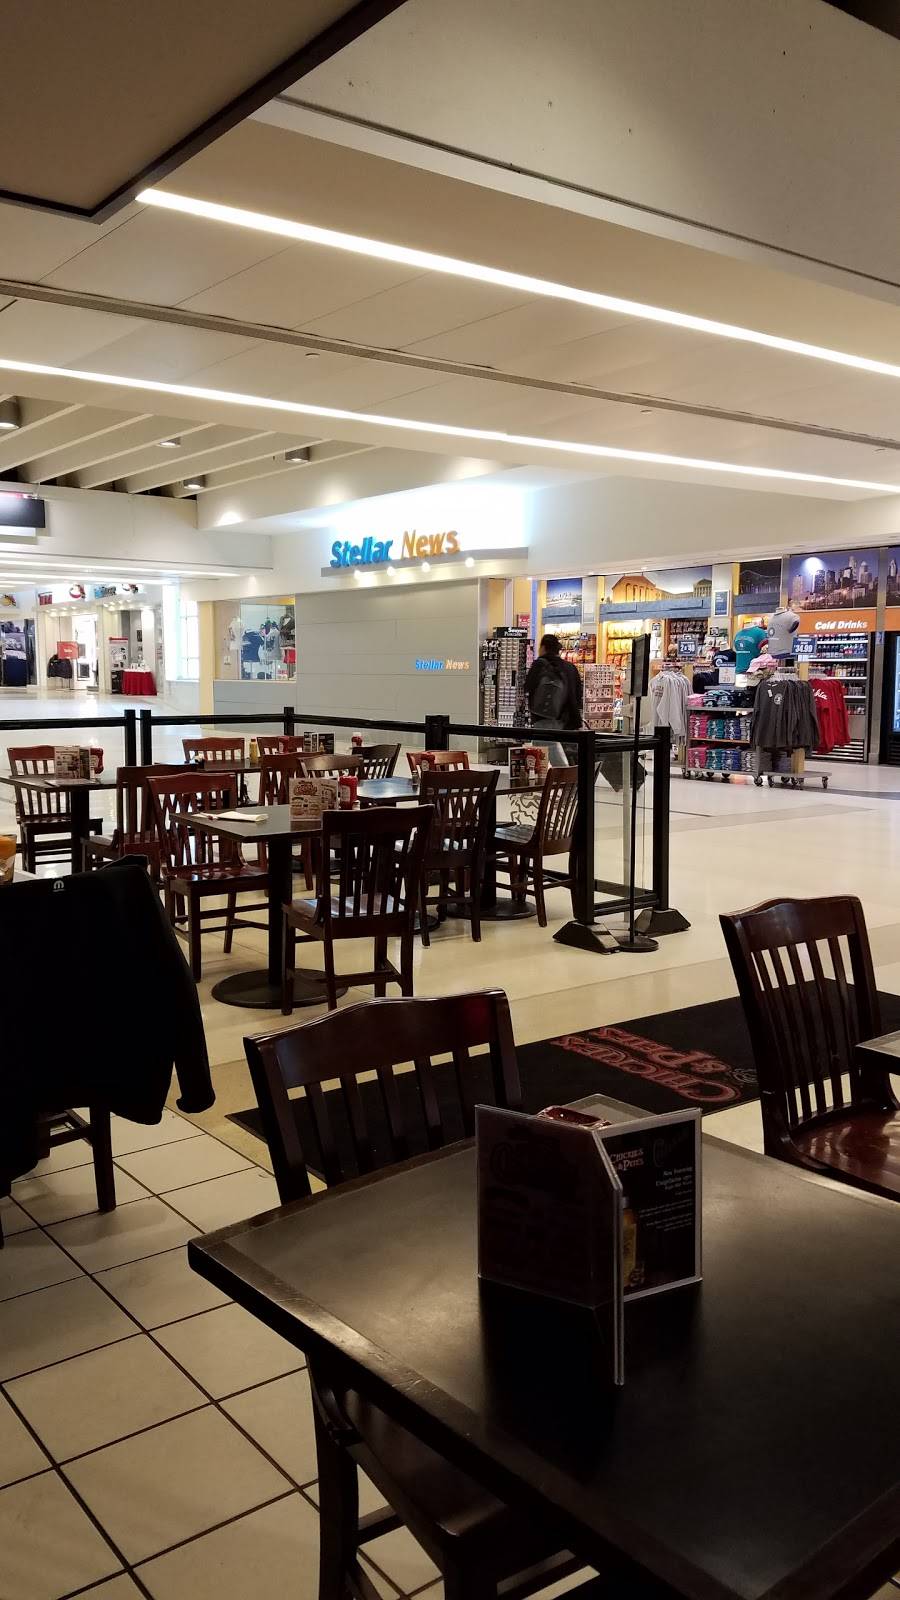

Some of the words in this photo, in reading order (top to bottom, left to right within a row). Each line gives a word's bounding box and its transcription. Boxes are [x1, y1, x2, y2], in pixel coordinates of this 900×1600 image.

[330, 536, 394, 568] Stellar
[401, 529, 461, 560] News
[815, 621, 837, 631] Cold
[837, 620, 869, 630] Drinks
[415, 658, 443, 670] Stellar
[445, 659, 470, 670] News
